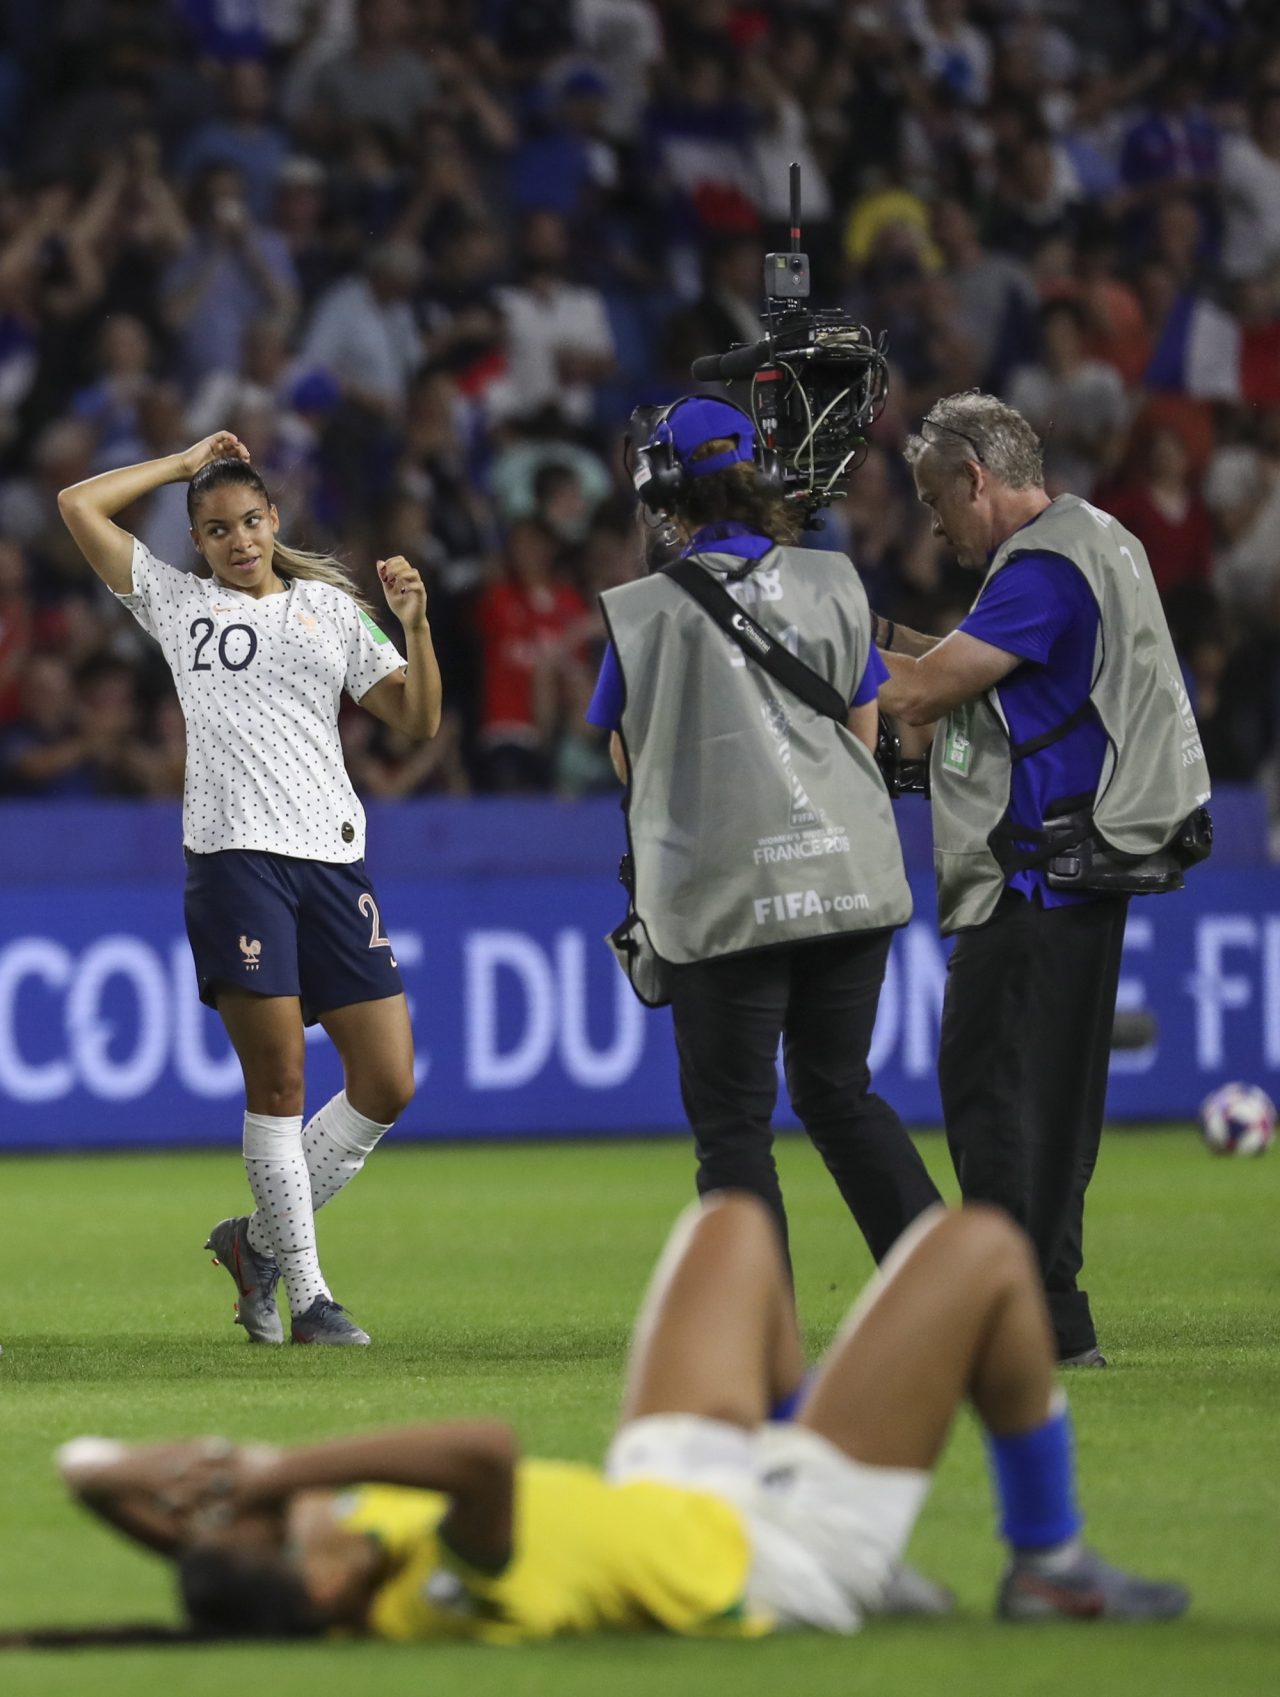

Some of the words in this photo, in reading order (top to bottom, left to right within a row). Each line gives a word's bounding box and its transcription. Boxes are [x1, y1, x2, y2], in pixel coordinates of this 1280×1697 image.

[190, 617, 257, 672] 20
[753, 839, 821, 866] FRANCE
[462, 928, 646, 1093] DU
